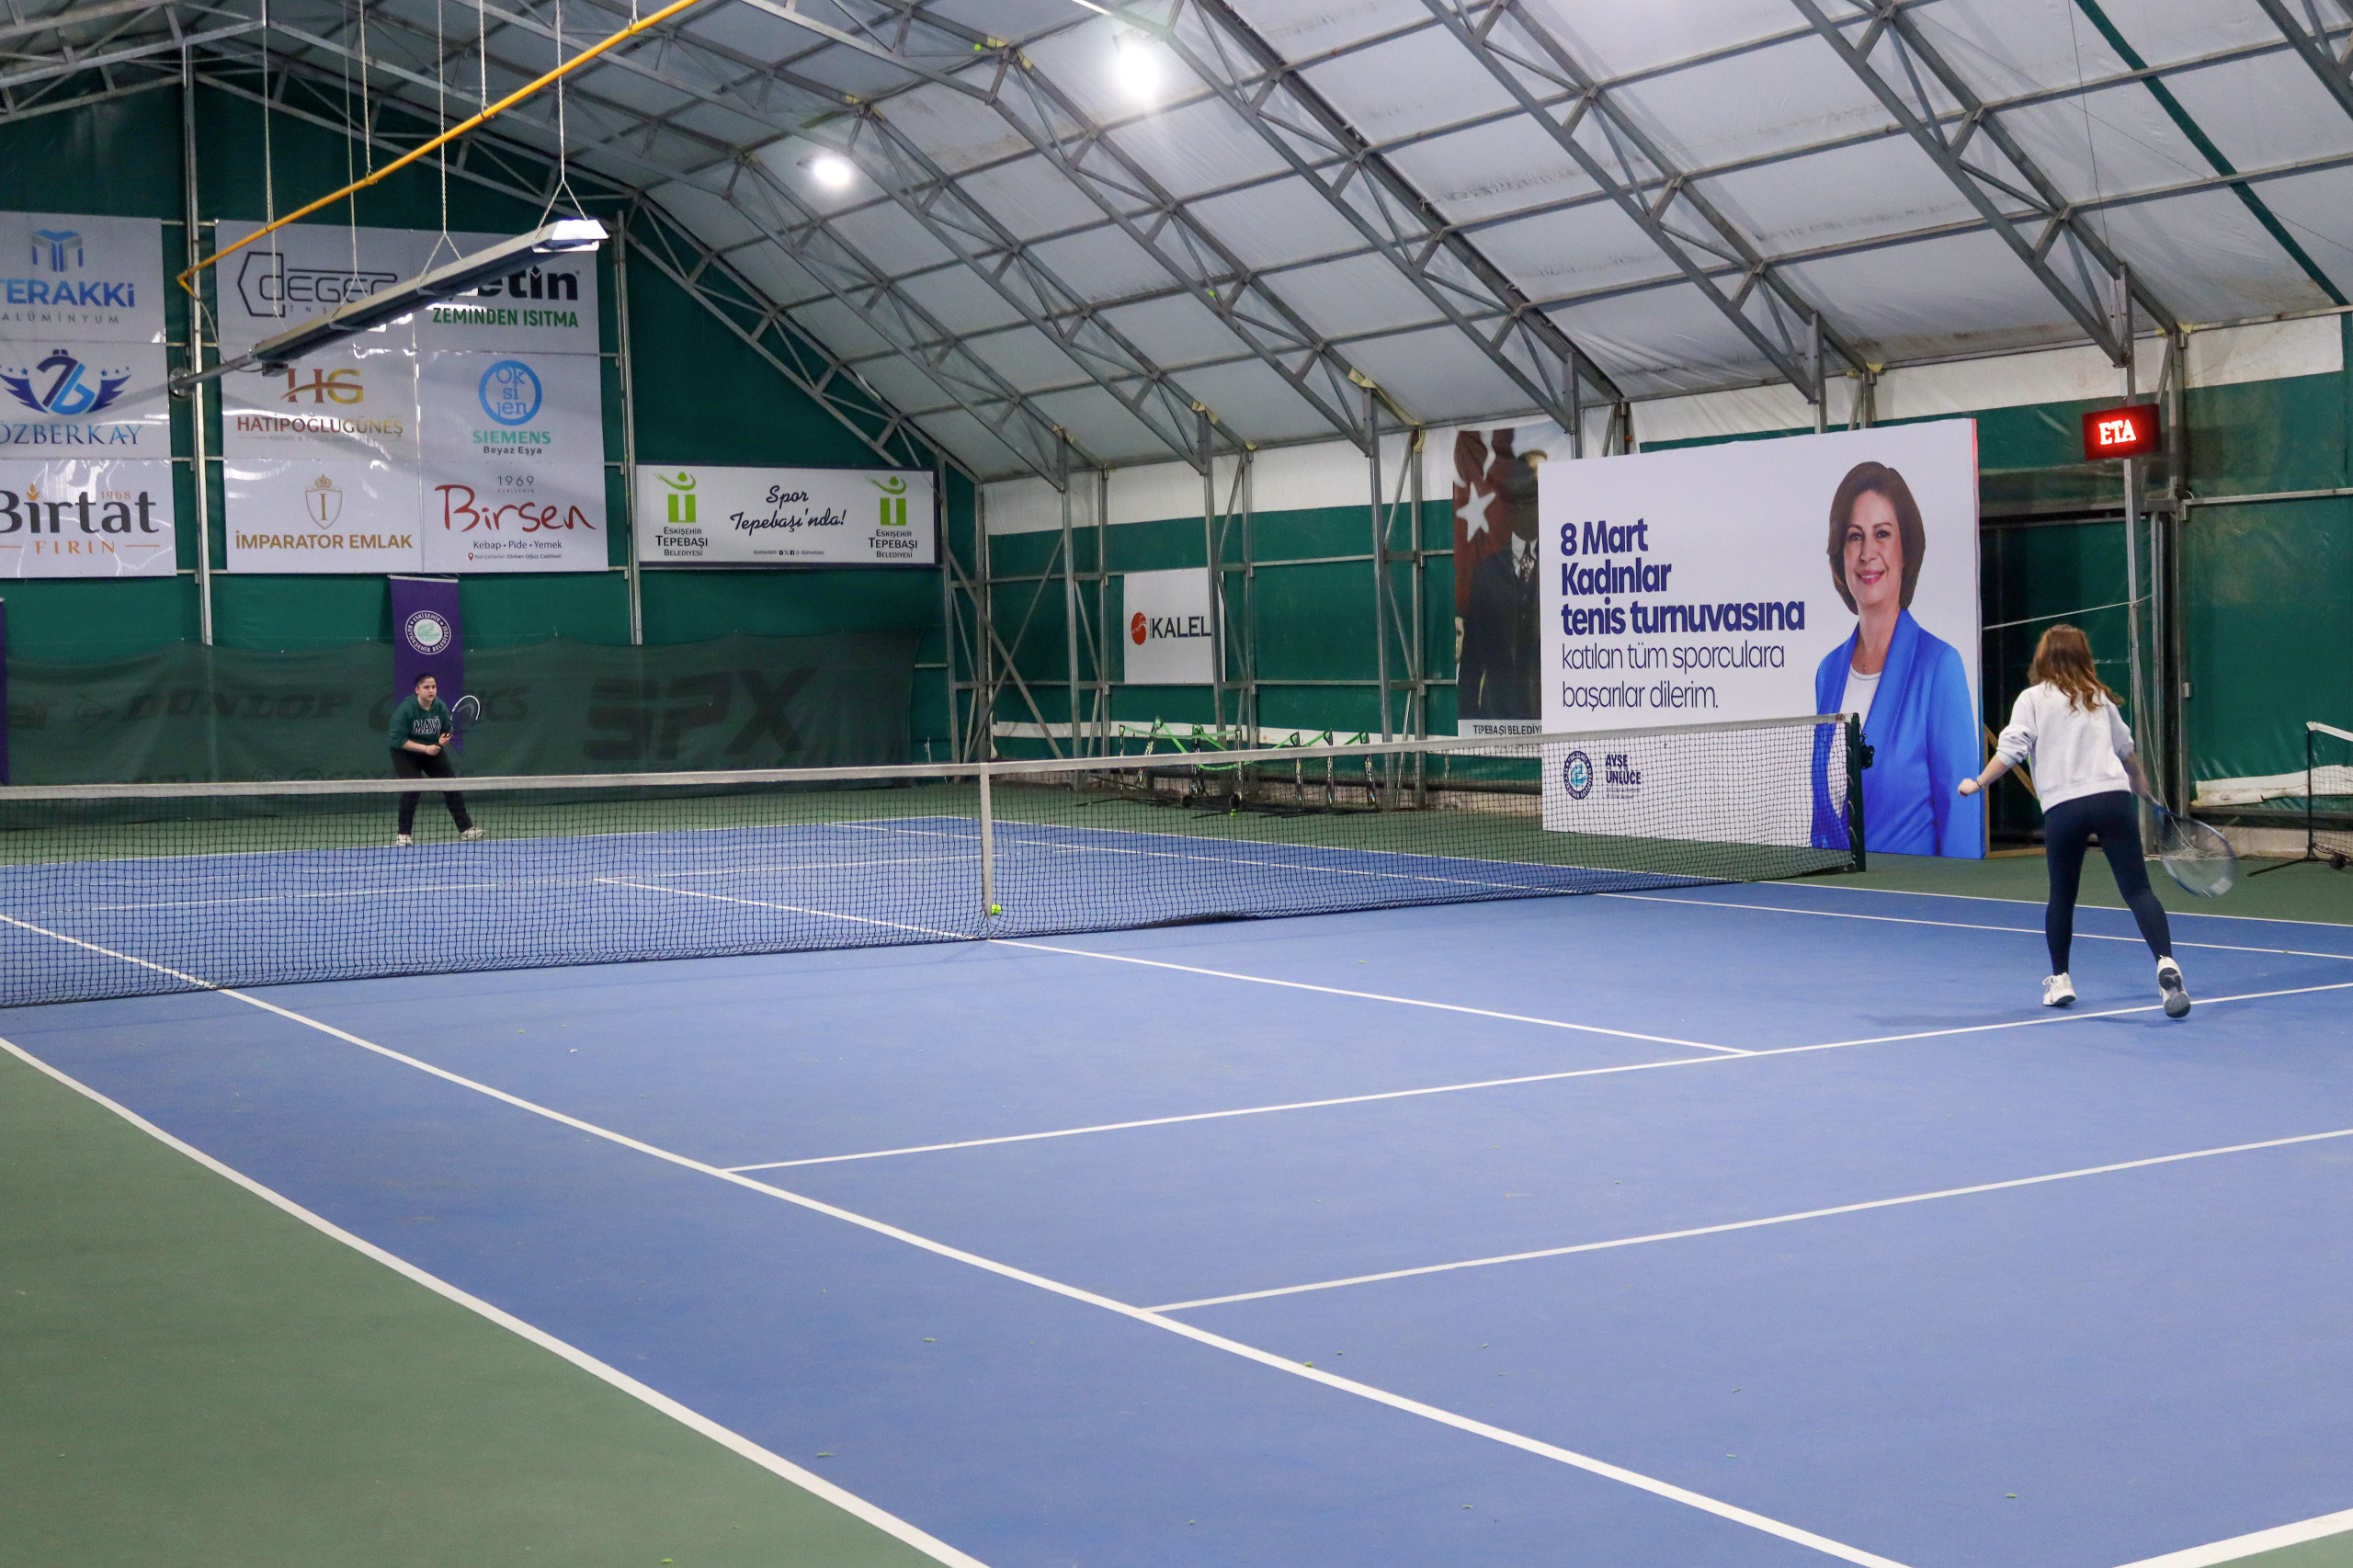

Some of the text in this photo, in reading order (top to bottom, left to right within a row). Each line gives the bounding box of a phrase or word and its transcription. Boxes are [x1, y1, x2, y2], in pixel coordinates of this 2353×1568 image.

[450, 266, 578, 301] etin
[3, 311, 119, 324] ALÜMİNYUM
[433, 303, 579, 328] ZEMİNDEN ISITMA
[0, 420, 142, 445] ÖZBERKAY
[472, 430, 551, 445] SIEMENS
[483, 446, 542, 457] Beyaz Eşya
[497, 475, 535, 487] 1969
[101, 490, 132, 500] 1968
[766, 484, 809, 509] Spor
[0, 487, 160, 533] Birtat
[434, 483, 597, 533] Birsen
[730, 507, 847, 536] Tepebaşı'nda!
[34, 540, 116, 555] FIRIN
[235, 530, 413, 549] İMPARATOR EMLAK
[473, 540, 563, 551] Kebap Pide Yemek
[655, 535, 708, 549] TEPEBAŞI
[868, 537, 917, 551] TEPEBAŞI
[1561, 518, 1649, 556] 8 Mart
[1562, 557, 1672, 596] Kadınlar
[1562, 596, 1805, 636] tenis turnuvasına
[1563, 640, 1785, 675] katılan tüm sporculara
[1563, 680, 1719, 711] başarılar dilerim.
[1473, 723, 1542, 736] TEPEBAŞI BELEDİY
